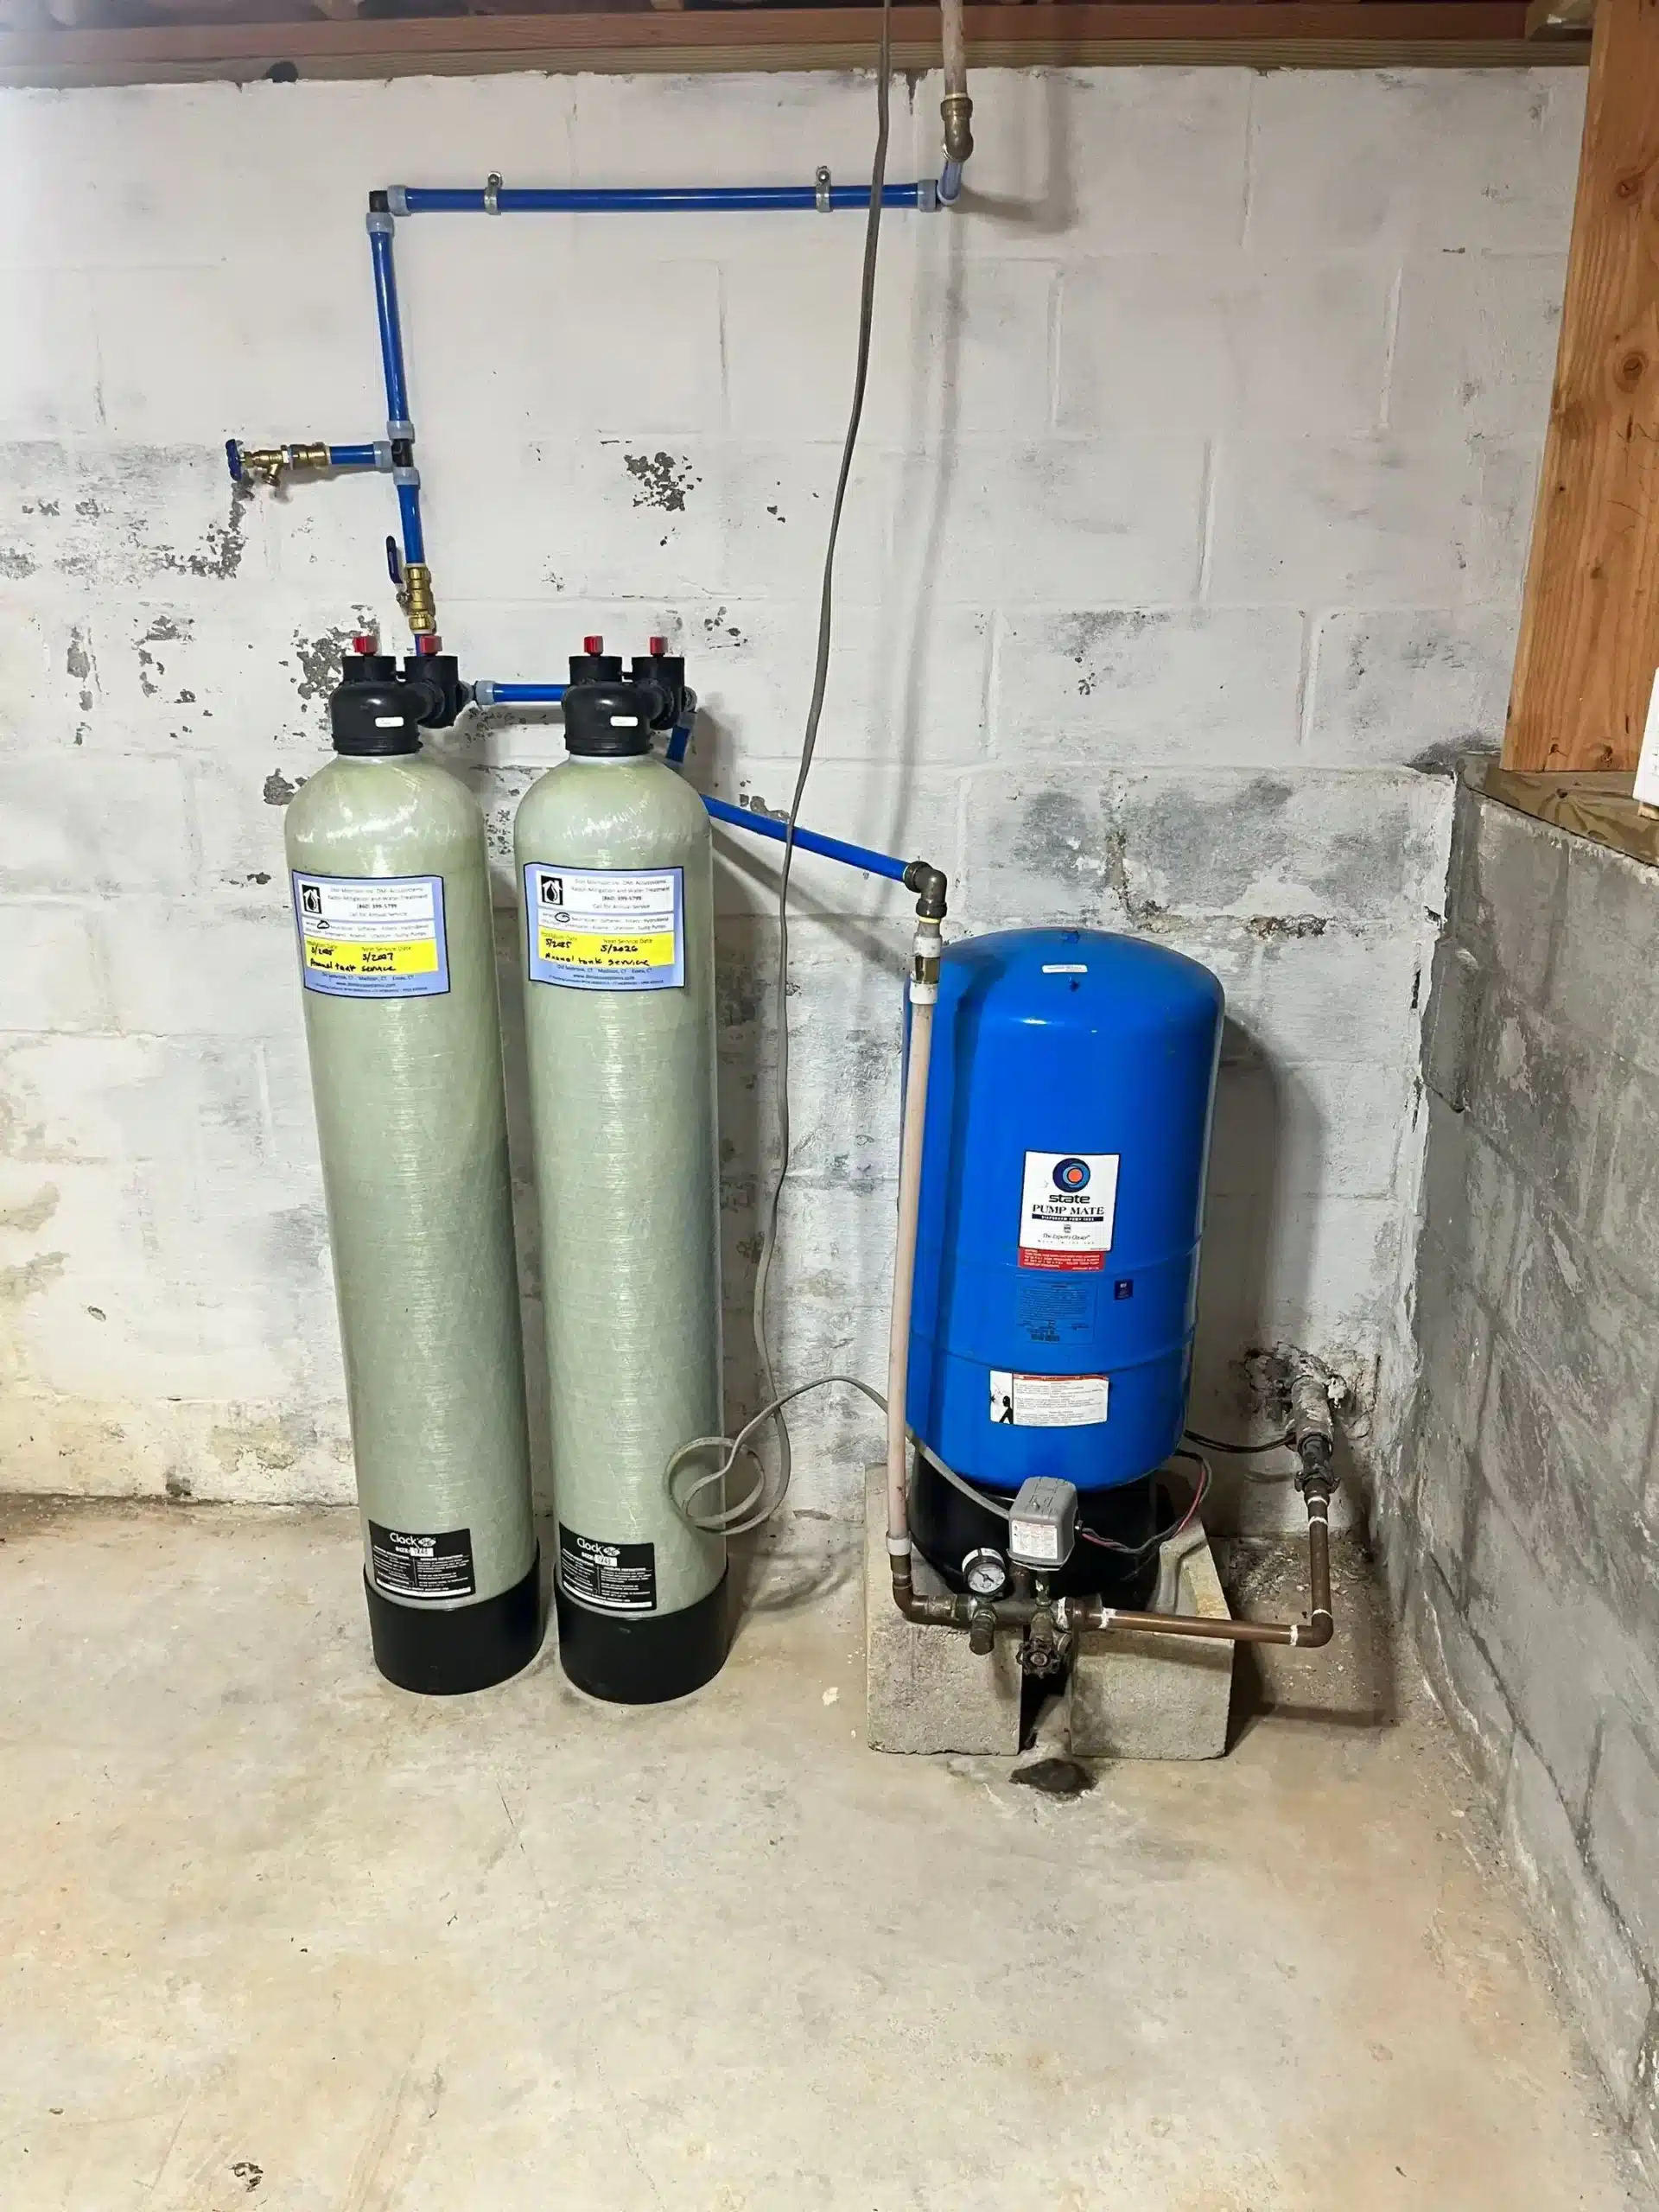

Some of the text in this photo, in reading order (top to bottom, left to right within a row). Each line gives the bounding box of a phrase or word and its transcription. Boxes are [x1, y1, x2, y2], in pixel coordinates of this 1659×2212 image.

[1049, 1194, 1090, 1204] state
[1033, 1205, 1104, 1215] PUMP MATE
